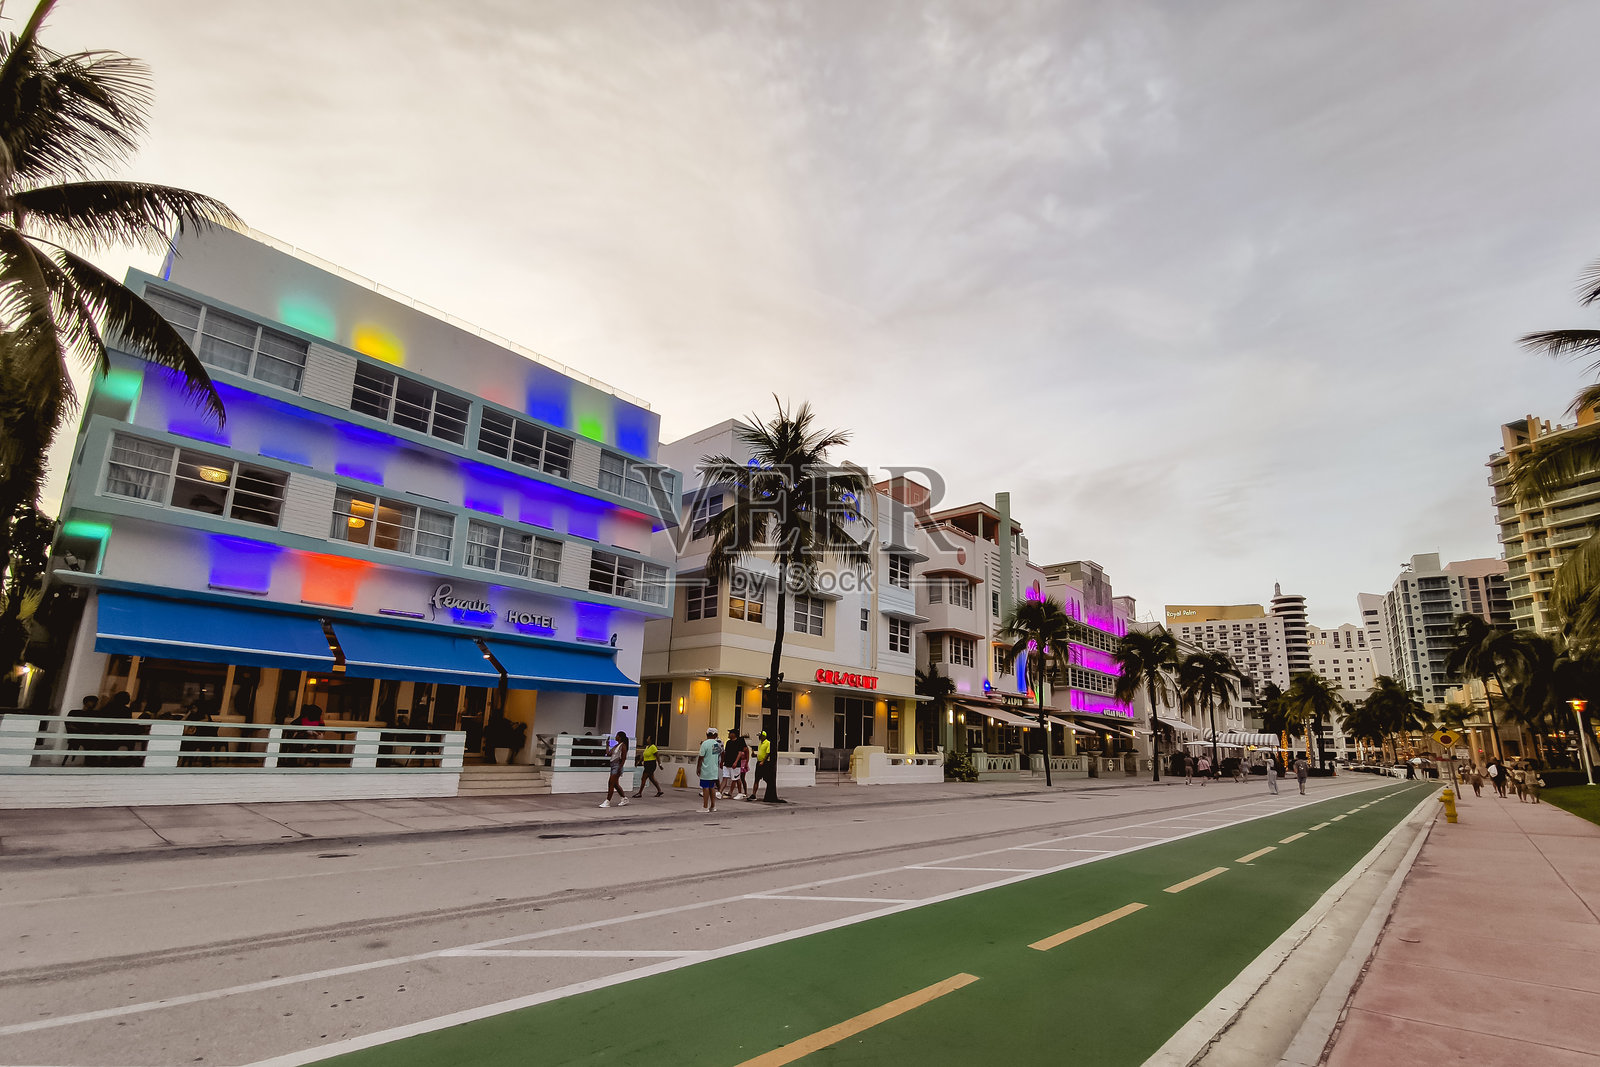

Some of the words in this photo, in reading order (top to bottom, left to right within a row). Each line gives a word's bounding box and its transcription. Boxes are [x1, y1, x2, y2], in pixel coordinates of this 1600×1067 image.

[429, 584, 496, 620] Penguin
[507, 610, 558, 630] HOTEL
[1166, 610, 1182, 619] Royal
[815, 668, 879, 690] CRESCENT
